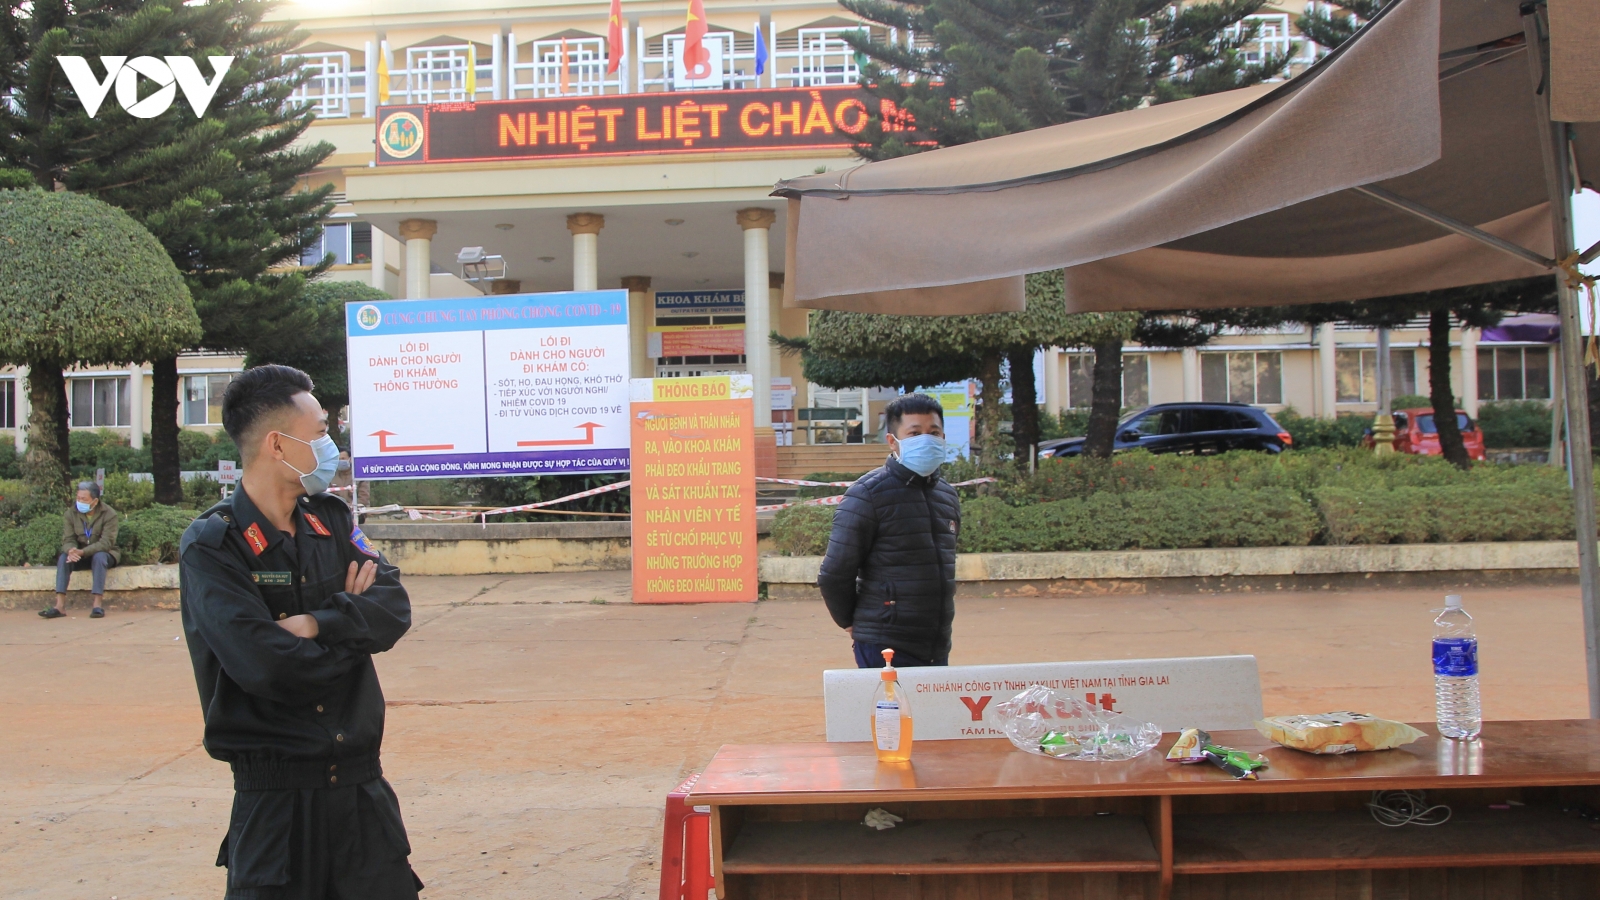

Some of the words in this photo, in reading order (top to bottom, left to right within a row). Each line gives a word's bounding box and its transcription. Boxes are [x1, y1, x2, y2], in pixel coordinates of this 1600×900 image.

[499, 105, 624, 150] NHIỆT
[637, 100, 728, 146] LIỆT
[740, 90, 869, 136] CHÀO
[657, 296, 691, 305] KHOA
[693, 293, 730, 304] KHÁM
[417, 309, 456, 324] CHUNG
[458, 308, 478, 322] TAY
[565, 303, 602, 317] COVID
[610, 303, 621, 316] 19
[399, 341, 416, 353] LỐI
[419, 342, 429, 352] ĐI
[540, 335, 558, 347] LỐI
[560, 336, 571, 346] ĐI
[369, 355, 398, 367] DÀNH
[400, 355, 423, 366] CHO
[426, 351, 461, 364] NGƯỜI
[510, 349, 540, 361] DÀNH
[542, 350, 566, 360] CHO
[569, 346, 605, 359] NGƯỜI
[393, 368, 404, 379] ĐI
[406, 366, 437, 378] KHÁM
[523, 363, 534, 373] ĐI
[536, 360, 568, 373] KHÁM
[570, 359, 589, 372] CÓ:
[373, 380, 410, 392] THÔNG
[412, 377, 458, 390] THƯỜNG
[518, 378, 533, 388] HO,
[535, 377, 553, 386] ĐAU
[583, 374, 603, 384] KHÓ
[604, 374, 623, 383] THỞ
[657, 382, 699, 398] THÔNG
[701, 380, 727, 397] BÁO
[498, 387, 517, 397] TIẾP
[518, 387, 536, 396] XÚC
[538, 386, 553, 396] VỚI
[555, 385, 583, 395] NGƯỜI
[528, 398, 555, 406] COVID
[499, 409, 508, 417] ĐI
[510, 408, 521, 417] TỪ
[524, 407, 547, 416] VÙNG
[549, 407, 569, 417] DỊCH
[571, 406, 597, 415] COVID
[600, 406, 609, 414] 19
[669, 413, 688, 433] BỆNH
[688, 412, 698, 429] VÀ
[699, 412, 719, 429] THÂN
[720, 411, 740, 429] NHÂN
[645, 440, 661, 456] RA,
[662, 437, 682, 454] VÀO
[684, 439, 711, 453] KHOA
[713, 435, 741, 452] KHÁM
[370, 463, 384, 473] SỨC
[385, 463, 404, 473] KHỎE
[405, 463, 419, 472] CỦA
[420, 463, 440, 472] CỘNG
[463, 461, 480, 470] KÍNH
[480, 461, 501, 470] MONG
[502, 460, 521, 470] NHẬN
[522, 460, 543, 470] ĐƯỢC
[544, 460, 555, 470] SỰ
[556, 460, 571, 469] HỢP
[572, 457, 586, 467] TÁC
[587, 457, 602, 466] CỦA
[602, 456, 618, 466] QUÝ
[618, 458, 626, 467] VỊ
[645, 460, 665, 477] PHẢI
[666, 463, 685, 477] ĐEO
[687, 457, 710, 476] KHẨU
[711, 461, 741, 476] TRANG
[645, 483, 660, 500] VÀ
[661, 483, 681, 500] SÁT
[683, 479, 719, 499] KHUẨN
[720, 484, 741, 498] TAY.
[645, 506, 681, 523] NHÂN
[683, 505, 712, 523] VIÊN
[714, 508, 723, 522] Y
[725, 502, 741, 522] TẾ
[646, 529, 658, 547] SẼ
[659, 529, 672, 546] TỪ
[673, 527, 698, 546] CHỐI
[700, 531, 727, 549] PHỤC
[729, 531, 743, 549] VỤ
[646, 552, 680, 570] NHỮNG
[681, 552, 721, 569] TRƯỜNG
[722, 554, 743, 572] HỢP
[647, 576, 675, 593] KHÔNG
[676, 579, 693, 592] ĐEO
[694, 573, 715, 592] KHẨU
[717, 578, 743, 592] TRANG
[916, 683, 931, 693] CHI
[933, 681, 963, 693] NHÁNH
[965, 680, 991, 692] CÔNG
[993, 681, 1003, 691] TY
[1004, 680, 1026, 691] TNHH
[1061, 677, 1080, 690] VIỆT
[1082, 679, 1101, 688] NAM
[1103, 678, 1117, 689] TẠI
[1138, 676, 1155, 686] GIA
[1157, 675, 1170, 685] LAI
[960, 727, 985, 735] TÂM
